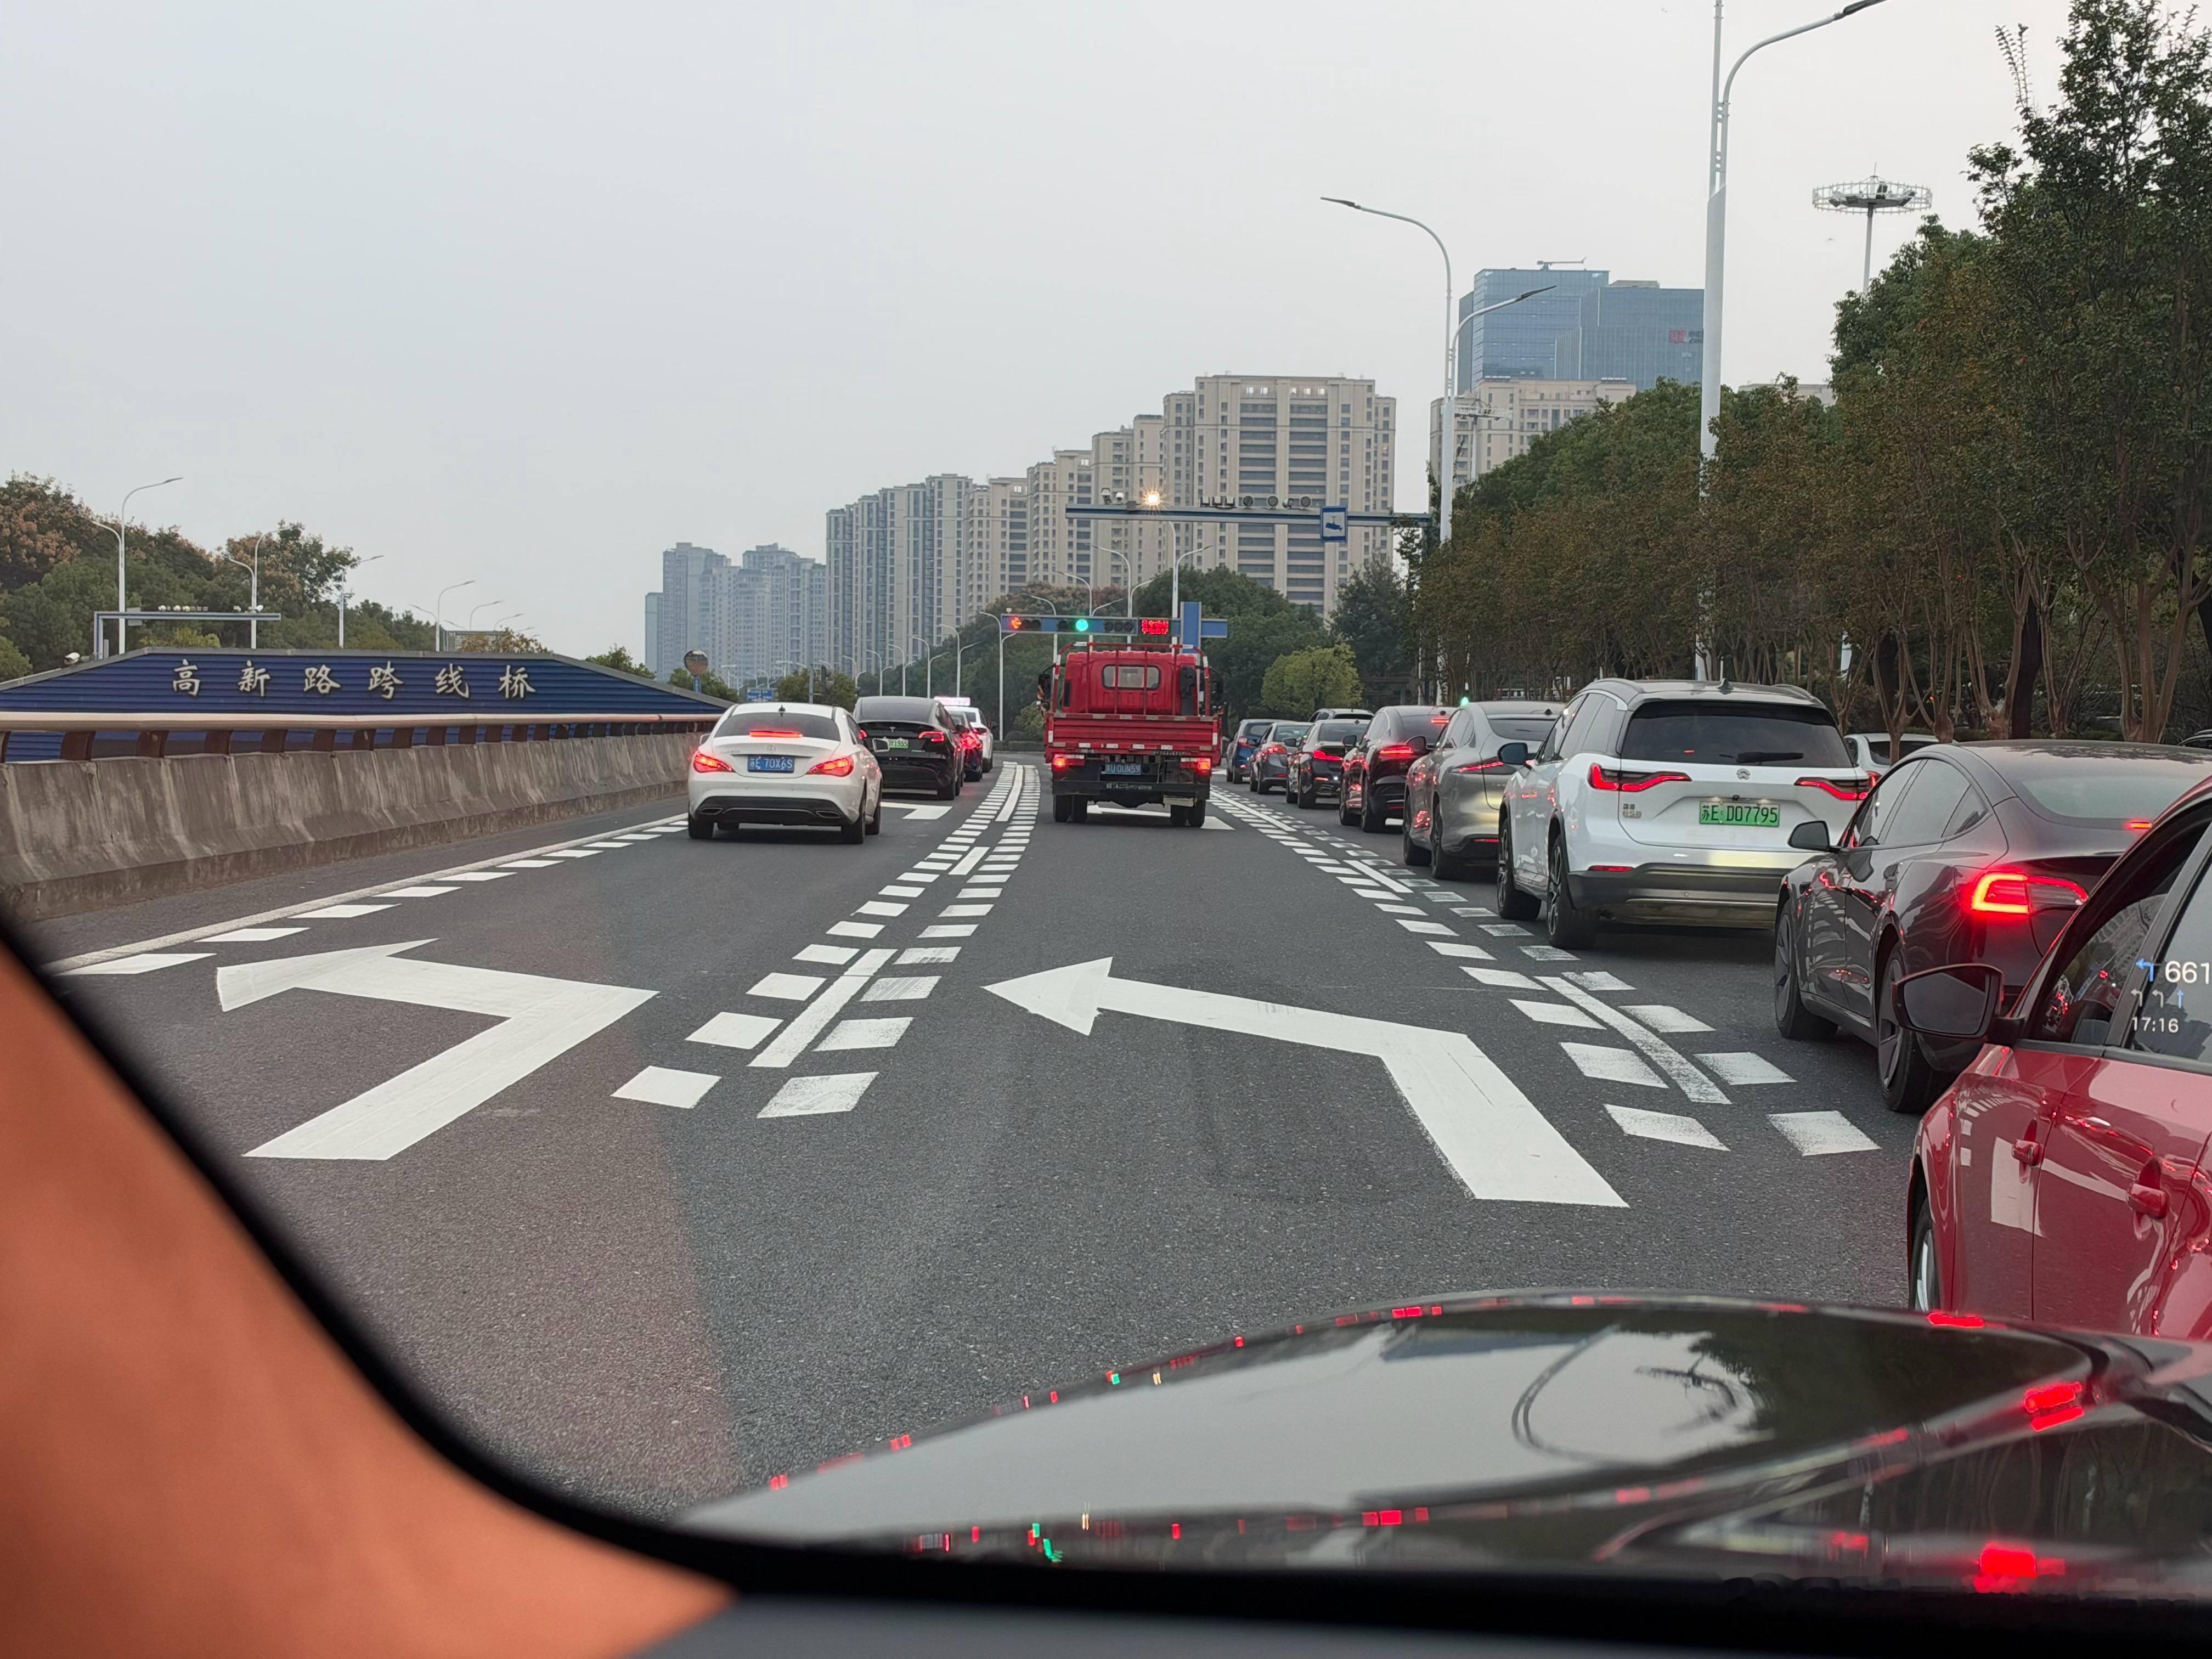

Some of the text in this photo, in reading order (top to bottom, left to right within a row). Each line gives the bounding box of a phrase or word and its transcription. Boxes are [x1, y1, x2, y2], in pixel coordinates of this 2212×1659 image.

[173, 659, 536, 699] 高新路跨线桥
[2165, 961, 2210, 984] 661
[2131, 1017, 2179, 1033] 17:16
